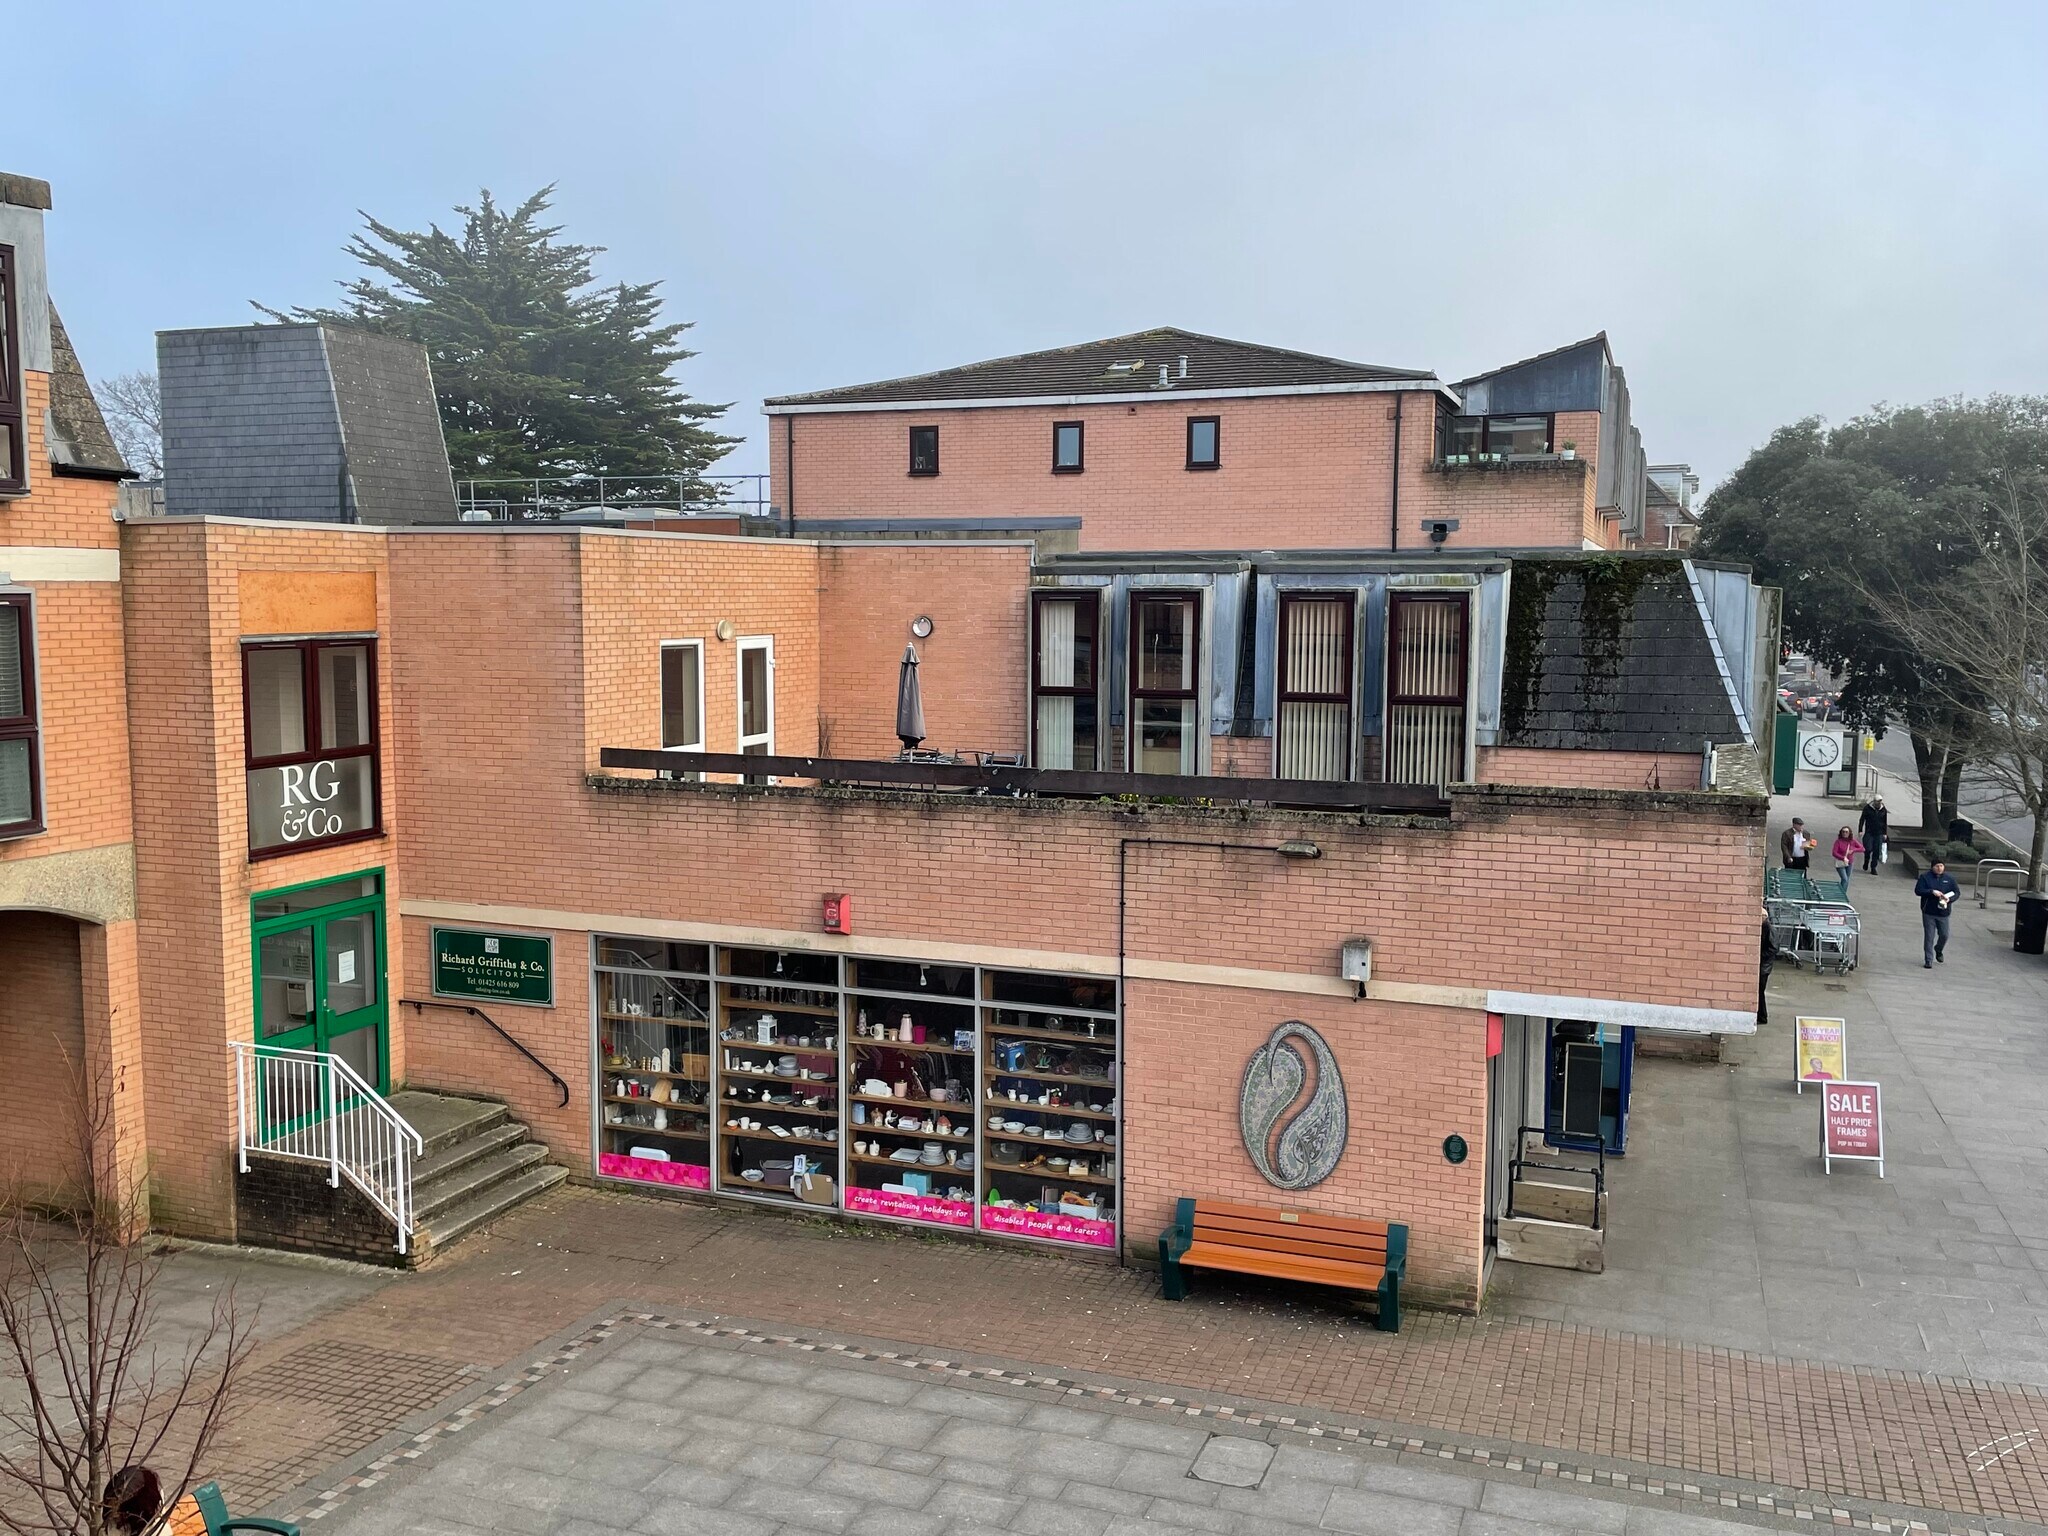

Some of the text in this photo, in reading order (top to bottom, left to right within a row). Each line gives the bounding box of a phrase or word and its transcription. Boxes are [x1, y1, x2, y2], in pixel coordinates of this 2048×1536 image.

[279, 761, 341, 808] RG
[281, 807, 342, 841] &Co
[441, 952, 545, 972] Richard Griffiths & Co.
[461, 966, 525, 979] SOLICITORS
[478, 978, 496, 987] 01425
[496, 980, 508, 988] 616
[508, 981, 520, 989] 809
[1822, 1034, 1839, 1042] YOU
[1830, 1093, 1872, 1114] SALE
[1831, 1116, 1872, 1127] HALF PRICE
[1837, 1127, 1867, 1137] FRAMES
[854, 1195, 968, 1218] create revitalising holidays for
[994, 1215, 1024, 1226] disabled
[1027, 1220, 1053, 1230] people
[1056, 1224, 1071, 1232] and
